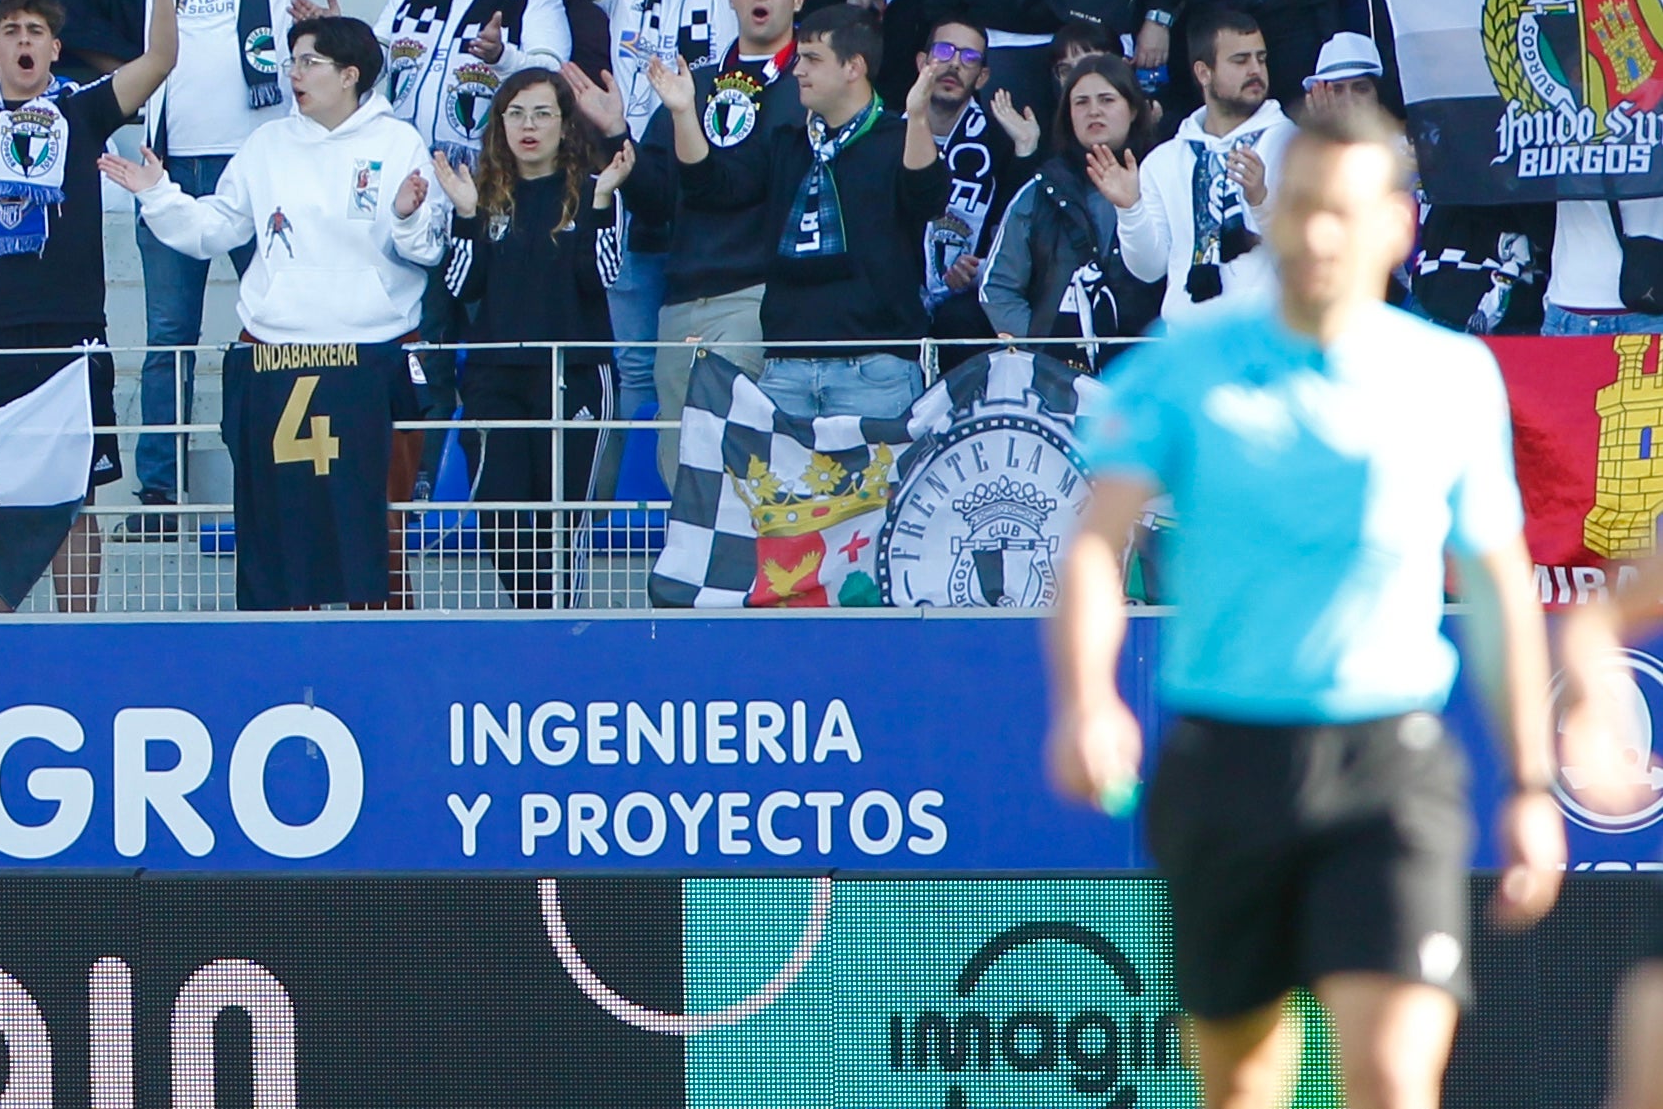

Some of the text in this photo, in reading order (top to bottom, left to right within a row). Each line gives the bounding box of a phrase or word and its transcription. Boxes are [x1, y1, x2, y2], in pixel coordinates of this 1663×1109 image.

[188, 2, 235, 15] SEGUR
[1523, 25, 1555, 97] BURGOS
[1518, 144, 1652, 178] BURGOS
[252, 343, 359, 373] UNDABARRENA
[272, 375, 339, 476] 4
[891, 440, 989, 563] FRENTE
[1006, 437, 1043, 475] LA
[987, 519, 1021, 538] CLUB
[449, 699, 862, 766] INGENIERIA
[447, 790, 949, 857] Y PROYECTOS
